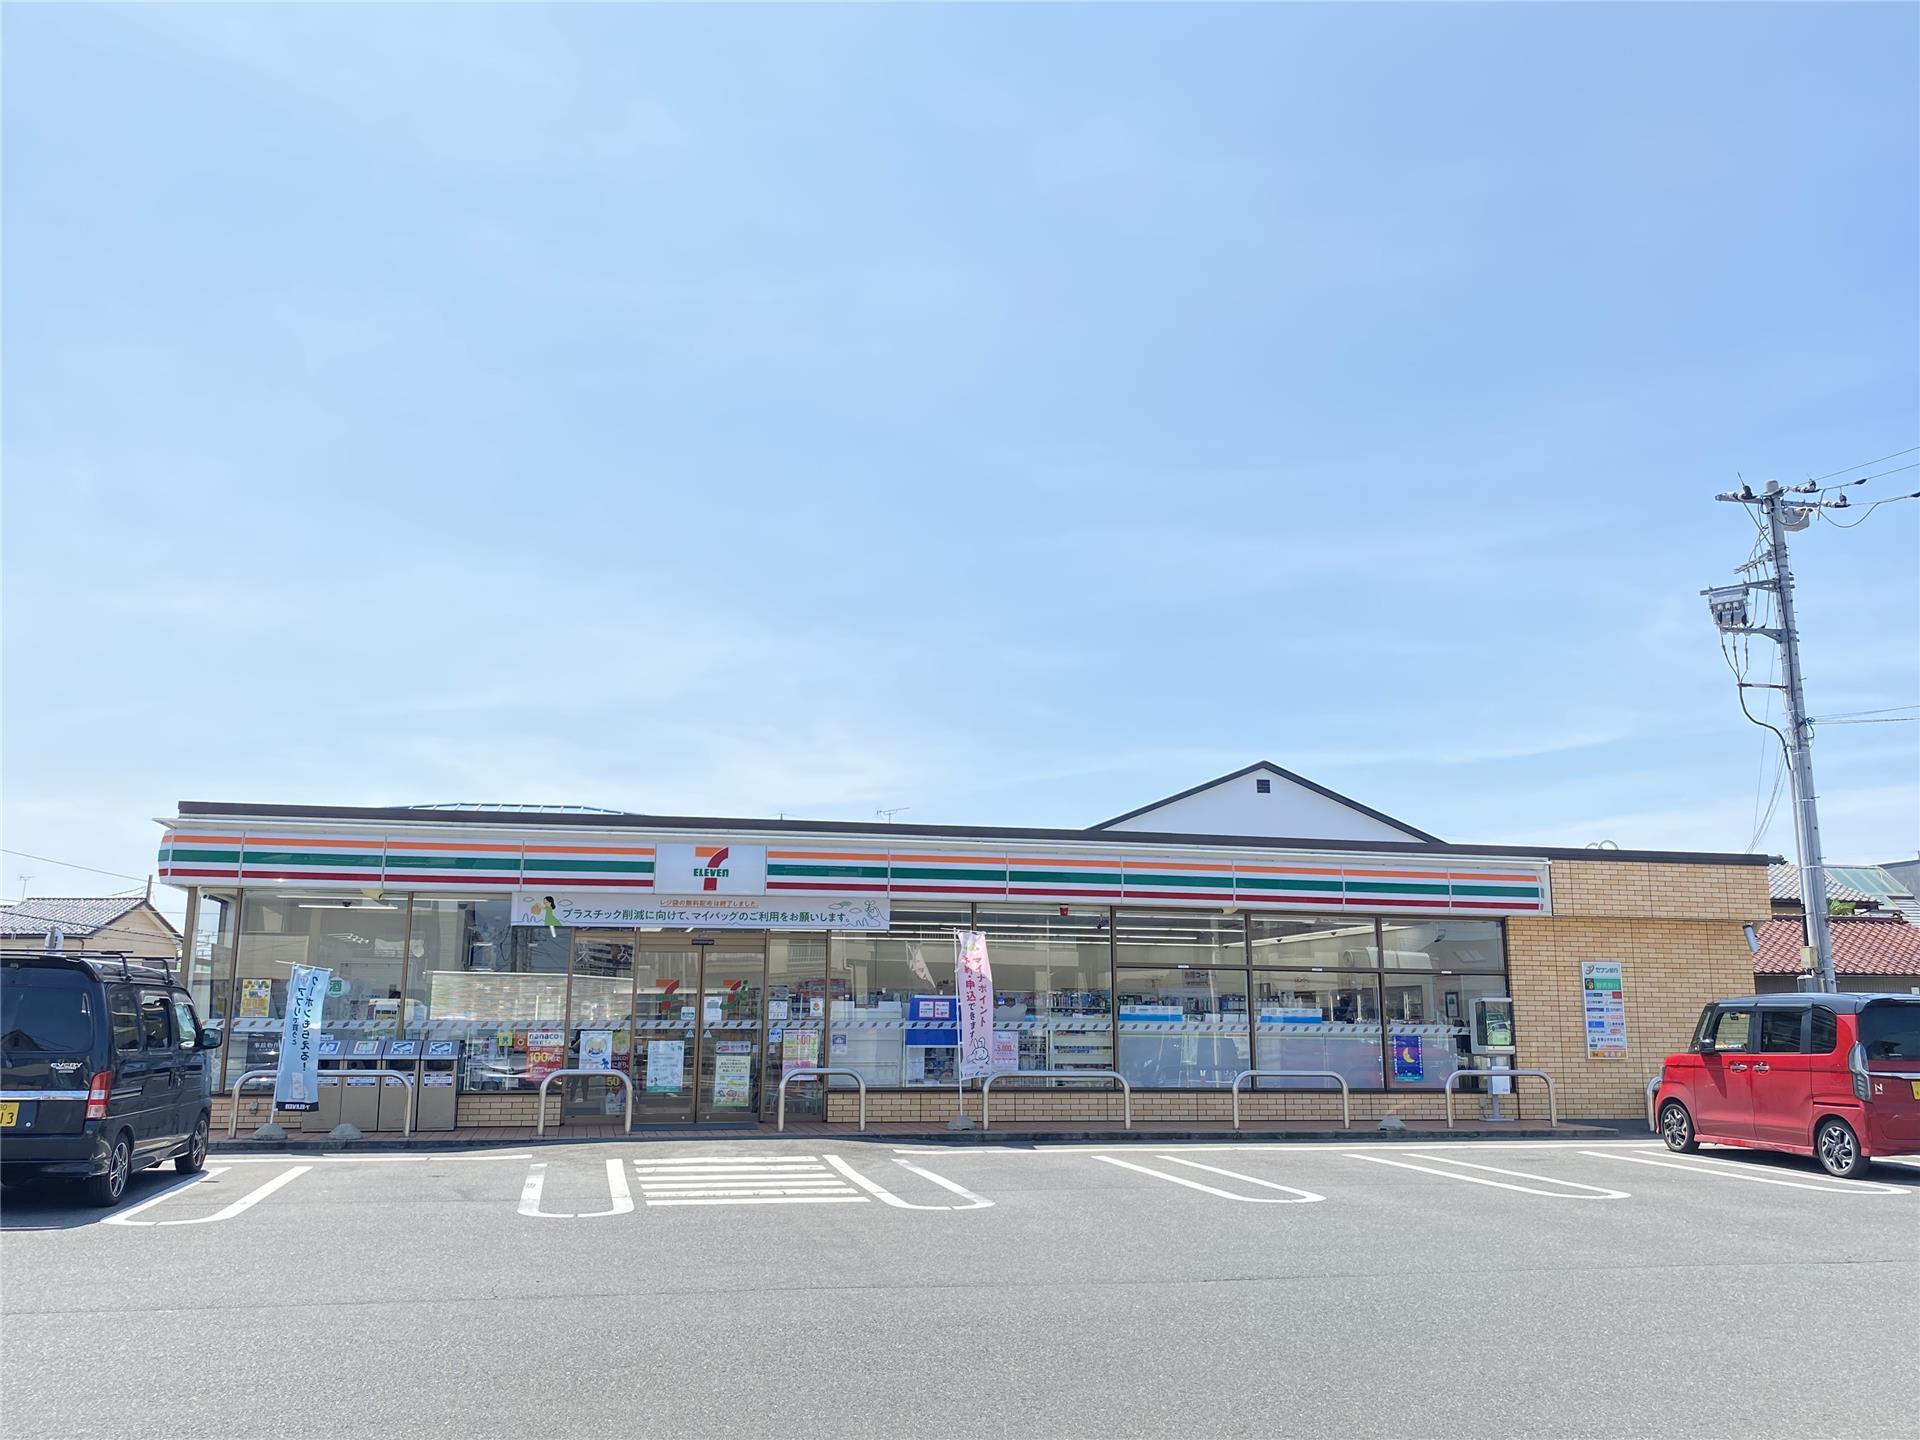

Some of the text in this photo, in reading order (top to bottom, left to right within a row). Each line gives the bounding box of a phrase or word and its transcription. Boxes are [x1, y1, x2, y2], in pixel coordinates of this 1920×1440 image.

[562, 908, 849, 923] プラスチック削減に向けて、マイバッグのご利用をお願いします。
[973, 957, 988, 1028] マイナポイント
